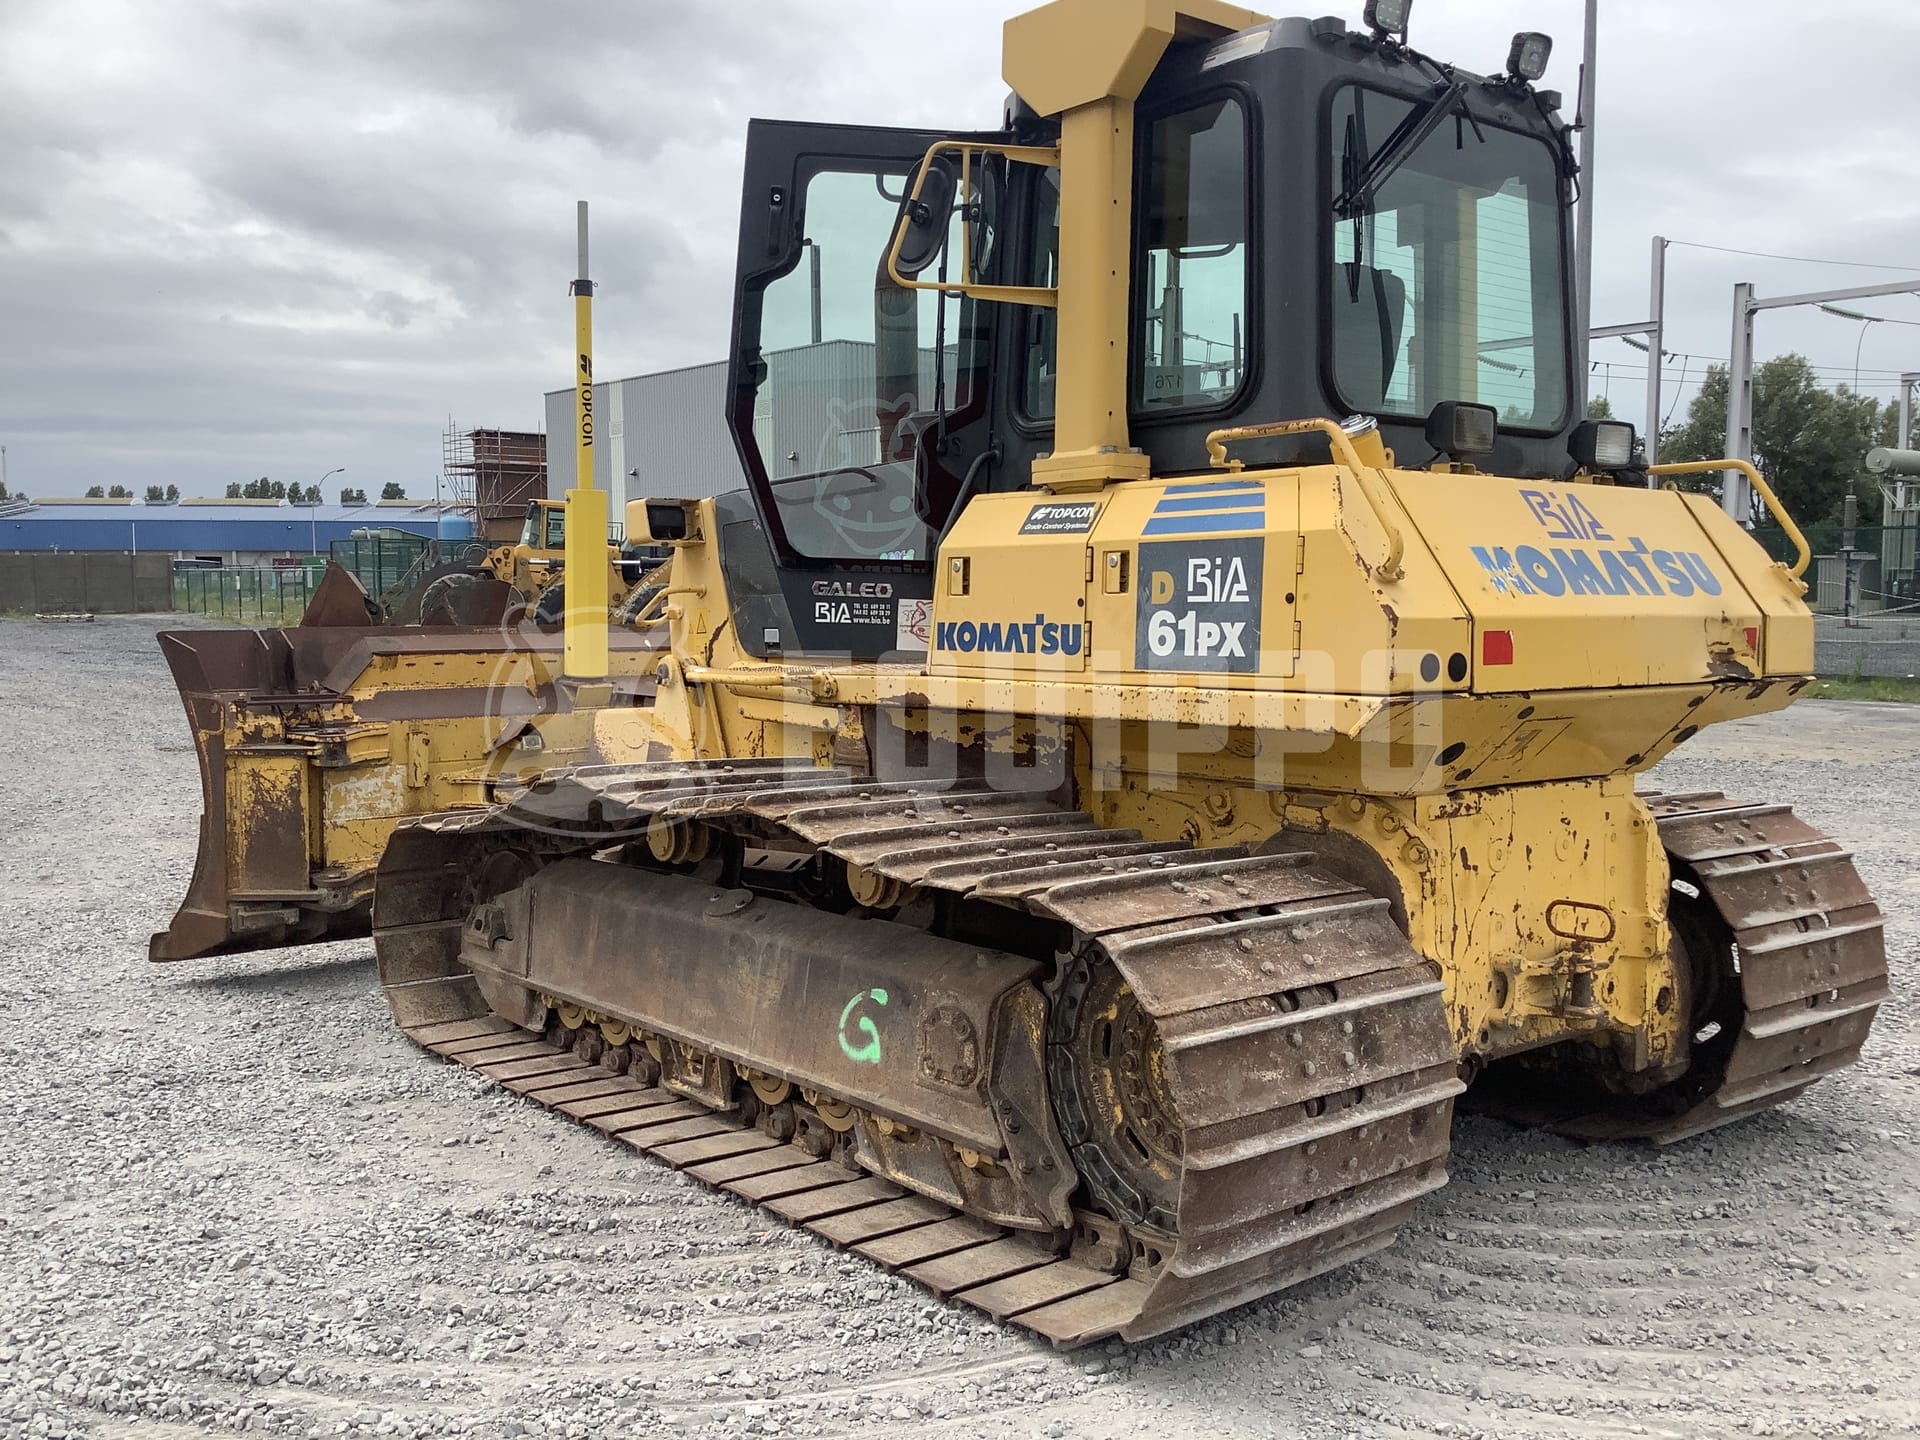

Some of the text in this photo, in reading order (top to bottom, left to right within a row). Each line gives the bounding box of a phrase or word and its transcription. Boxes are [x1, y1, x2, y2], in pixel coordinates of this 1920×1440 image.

[581, 382, 593, 447] TOPCON
[1024, 523, 1042, 531] Grade
[1064, 522, 1090, 530] Systems
[1048, 507, 1095, 519] TOPCON
[1469, 536, 1723, 597] KOMATSU
[811, 580, 894, 599] GALEO
[1151, 571, 1175, 605] D
[936, 612, 1082, 656] KOMATSU
[1147, 610, 1247, 657] 61PX
